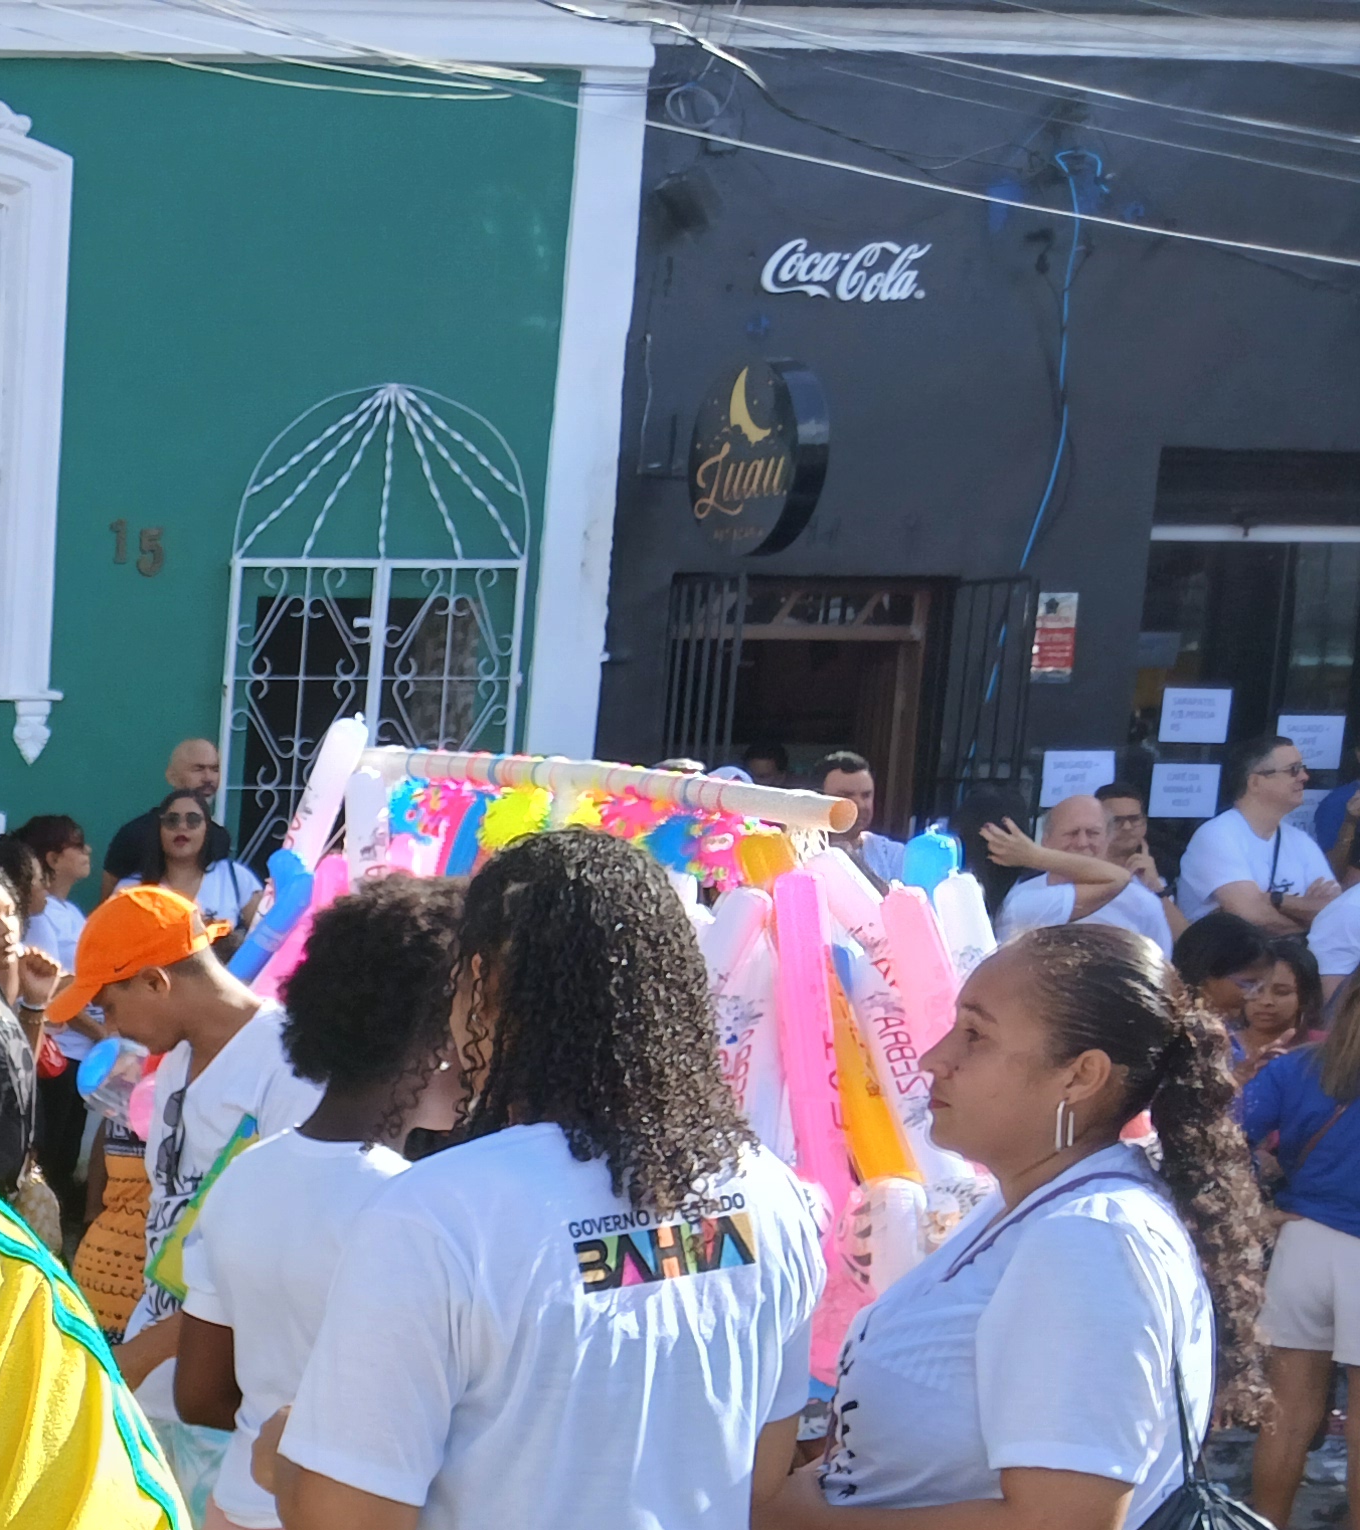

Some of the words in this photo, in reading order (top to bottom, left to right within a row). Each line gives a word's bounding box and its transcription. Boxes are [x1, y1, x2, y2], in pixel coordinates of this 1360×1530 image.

[760, 237, 932, 303] Coca-Cola
[109, 518, 166, 578] 15
[567, 1209, 651, 1240] GOVERNO
[680, 1192, 746, 1225] ESDO
[572, 1215, 757, 1296] BAHIA
